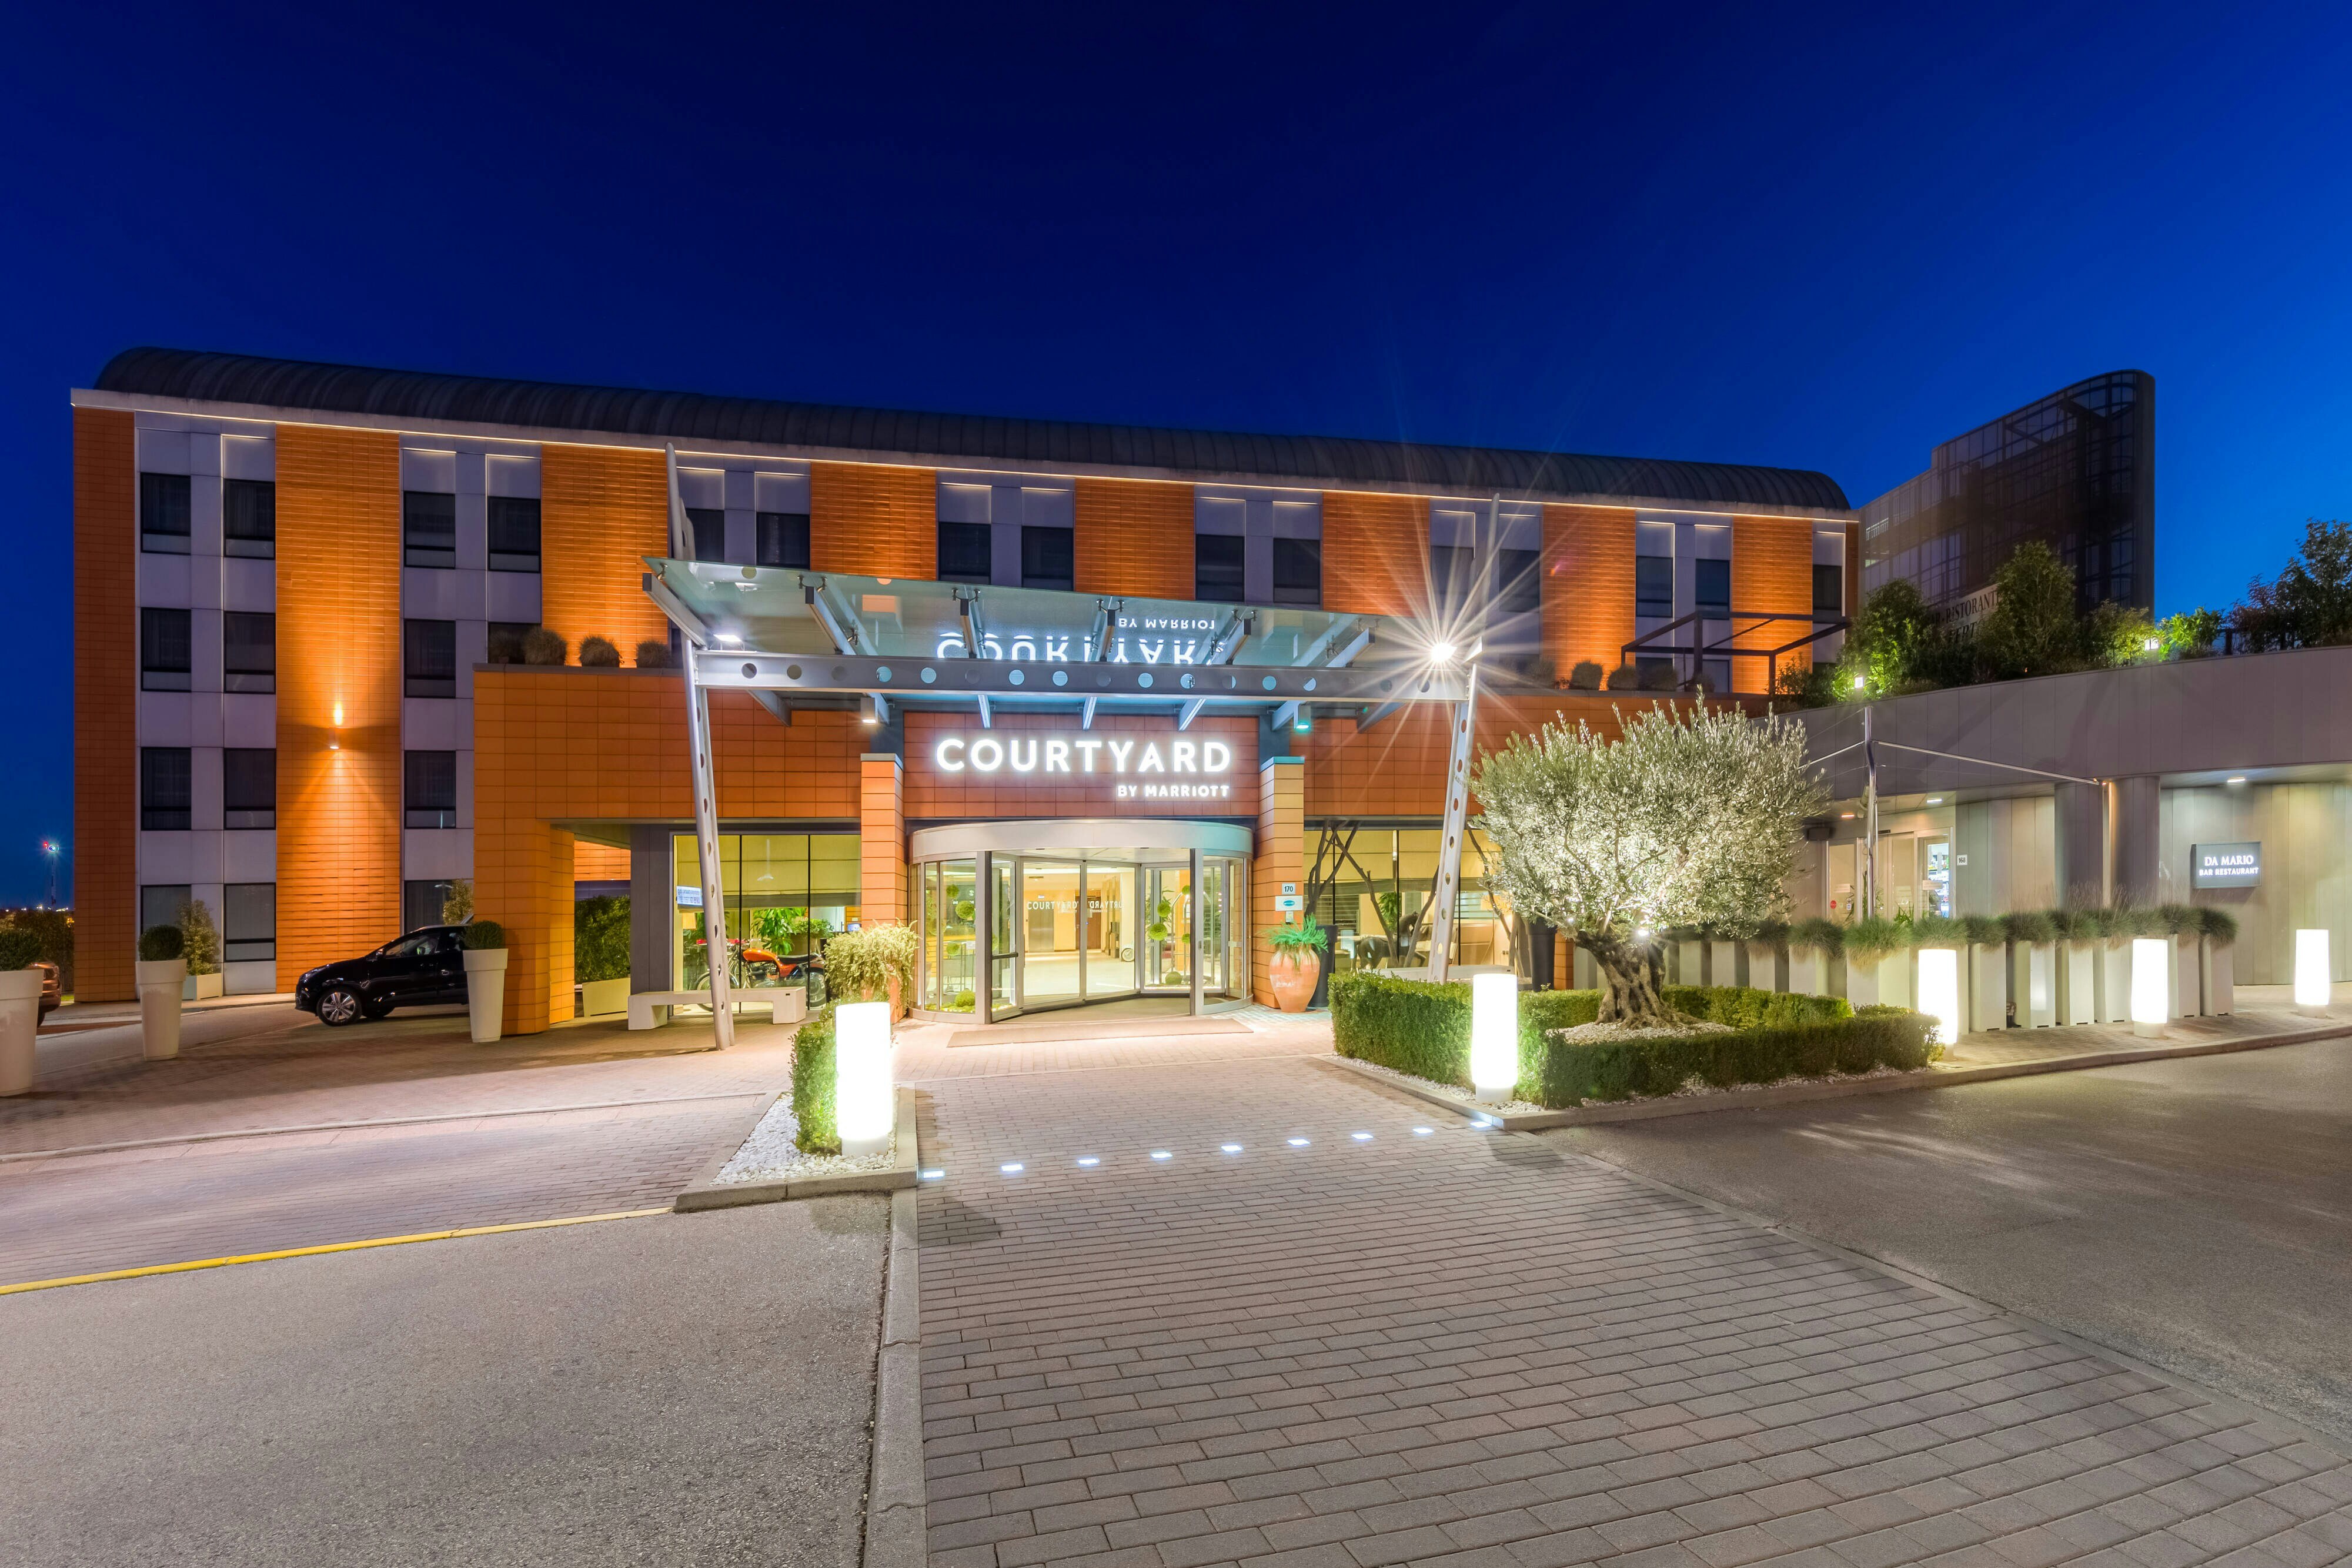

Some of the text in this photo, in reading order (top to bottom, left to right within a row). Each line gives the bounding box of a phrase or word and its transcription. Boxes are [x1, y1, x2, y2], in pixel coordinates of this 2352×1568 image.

[936, 738, 1231, 773] COURTYARD
[1118, 785, 1230, 797] BY MARRIOTT
[2204, 855, 2254, 866] DA MARIO
[2215, 867, 2259, 875] RESTAURANT
[1027, 901, 1078, 910] COURTYARD
